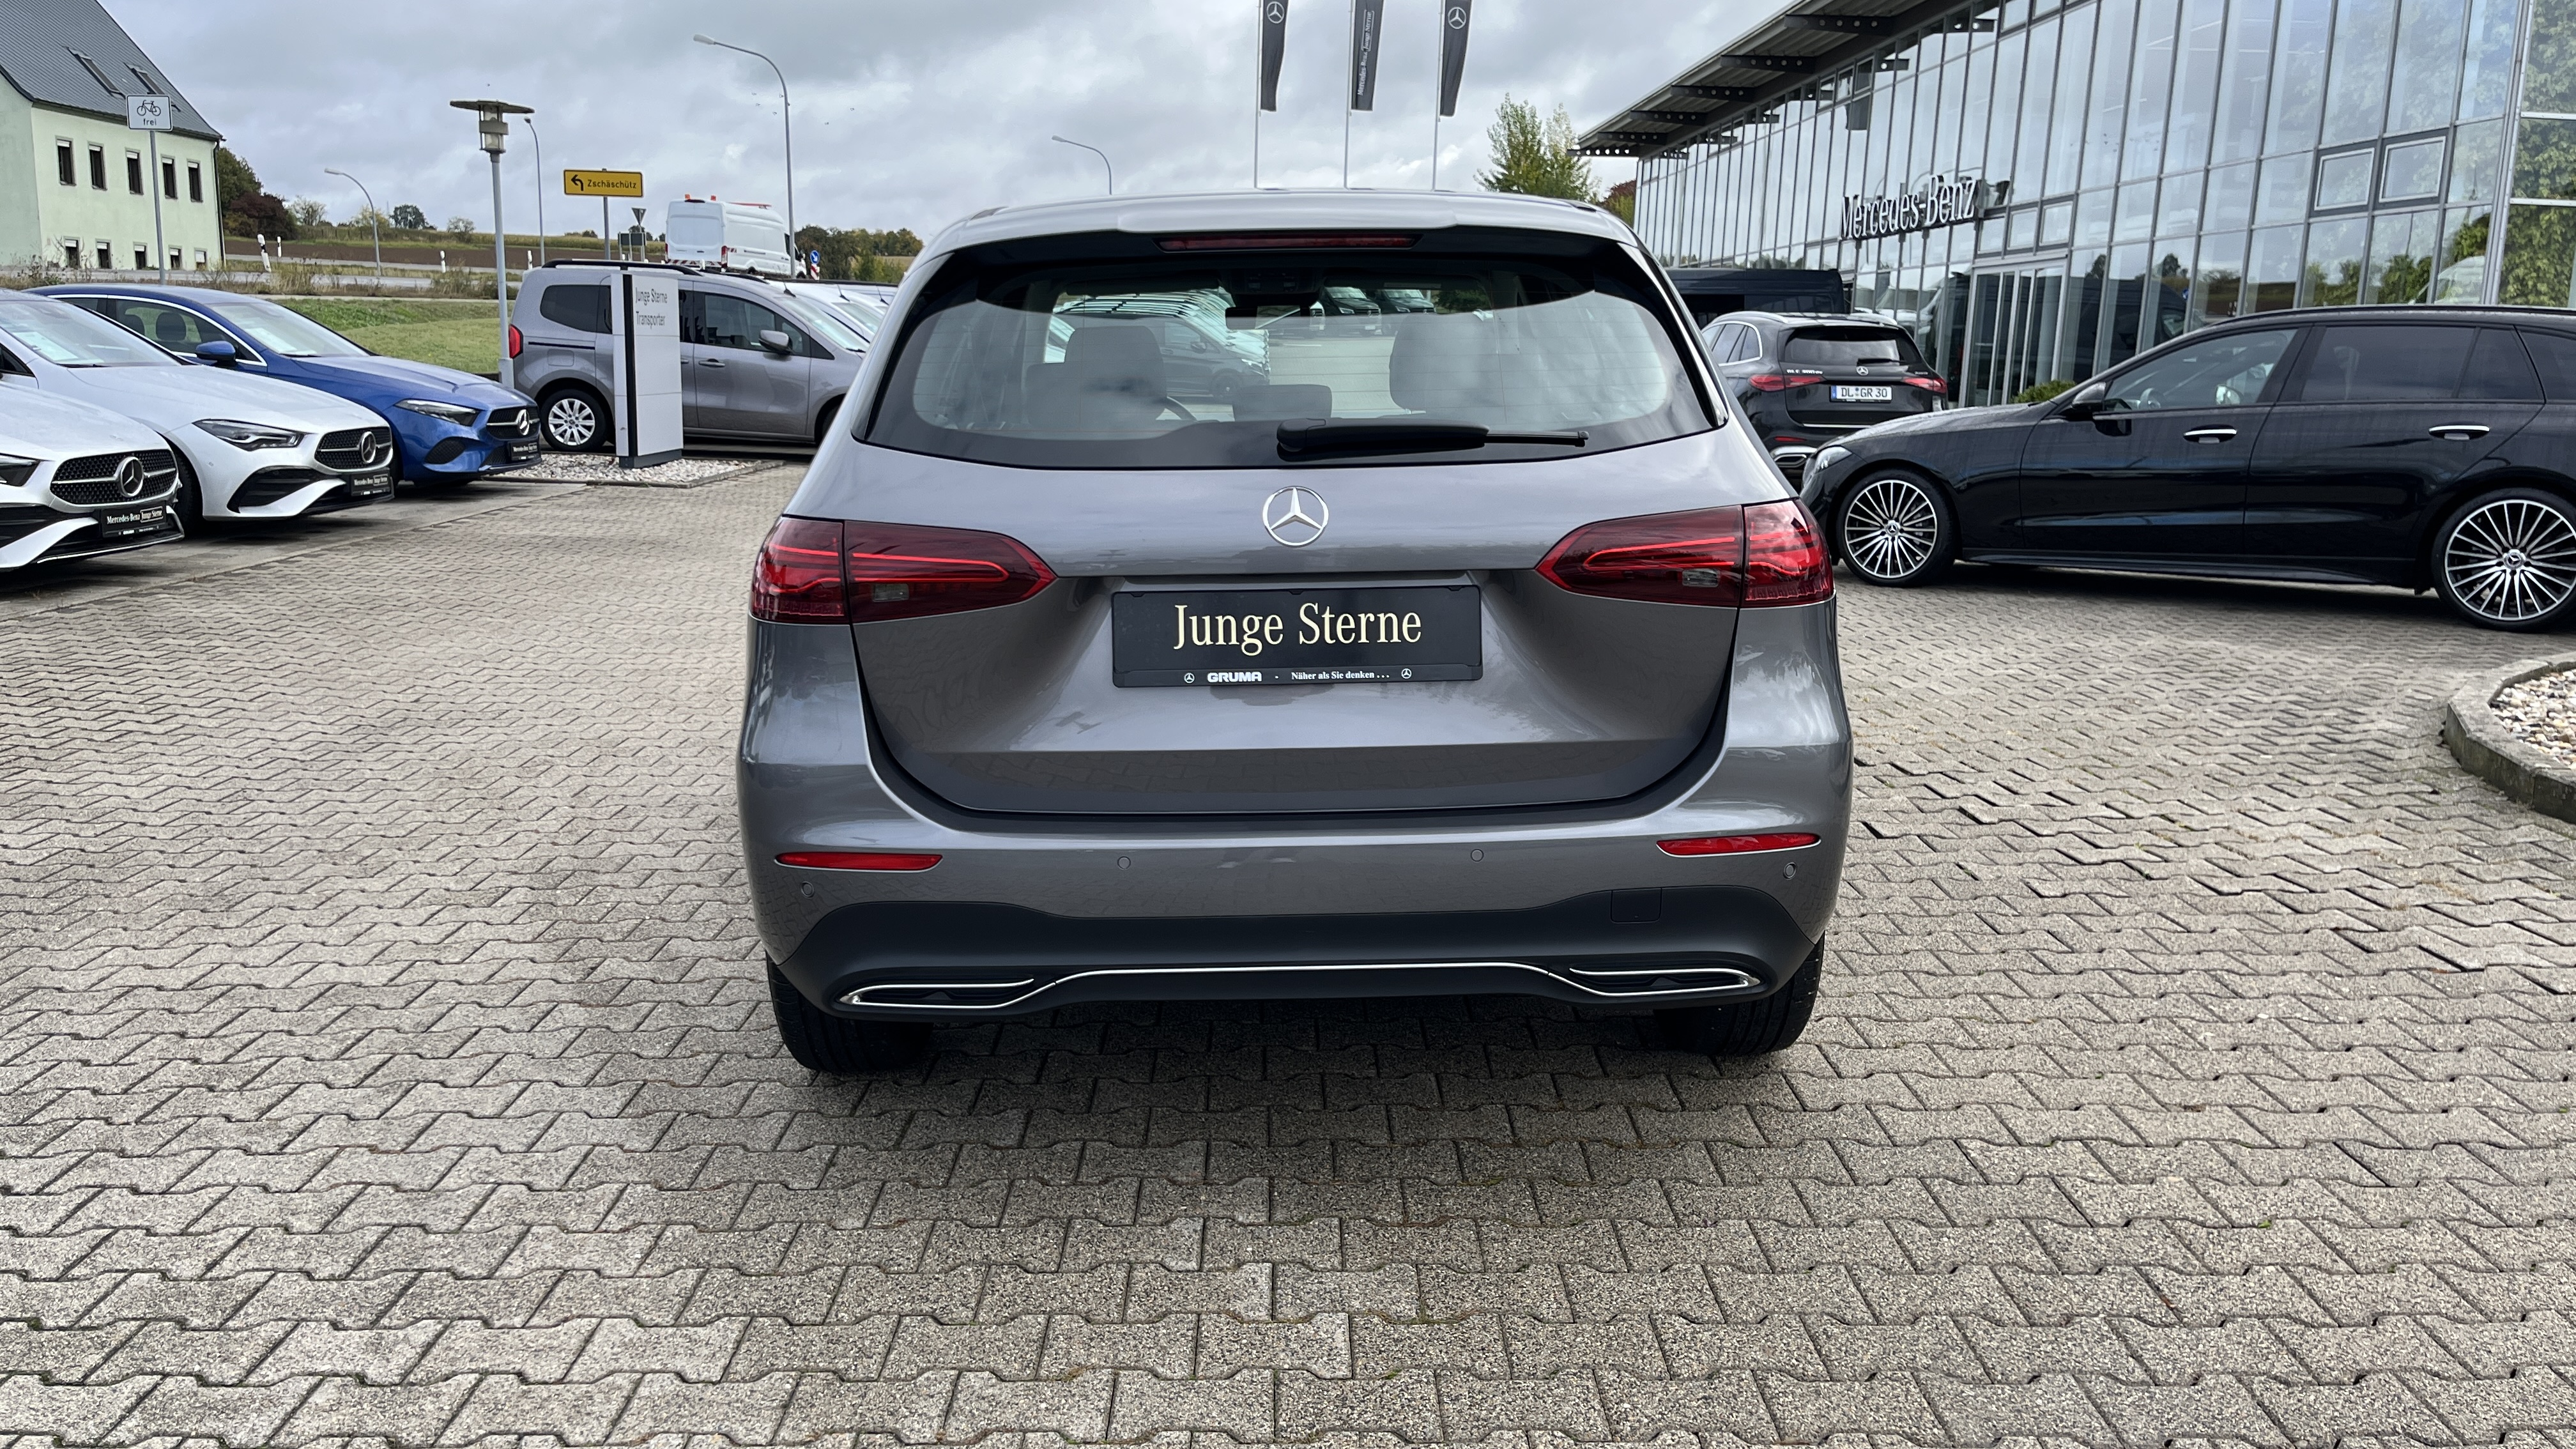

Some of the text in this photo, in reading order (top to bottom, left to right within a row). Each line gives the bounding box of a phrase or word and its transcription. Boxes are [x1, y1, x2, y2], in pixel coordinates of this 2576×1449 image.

[587, 180, 637, 188] Zschäschütz
[1839, 174, 1976, 238] Mercedes-Benz
[636, 288, 667, 306] Junge Sterne
[636, 311, 665, 329] Transporter
[1841, 387, 1887, 397] DL GR 30
[107, 513, 140, 524] Mercedes-Benz
[1174, 602, 1422, 656] Junge Sterne
[1208, 671, 1262, 682] GRUMA
